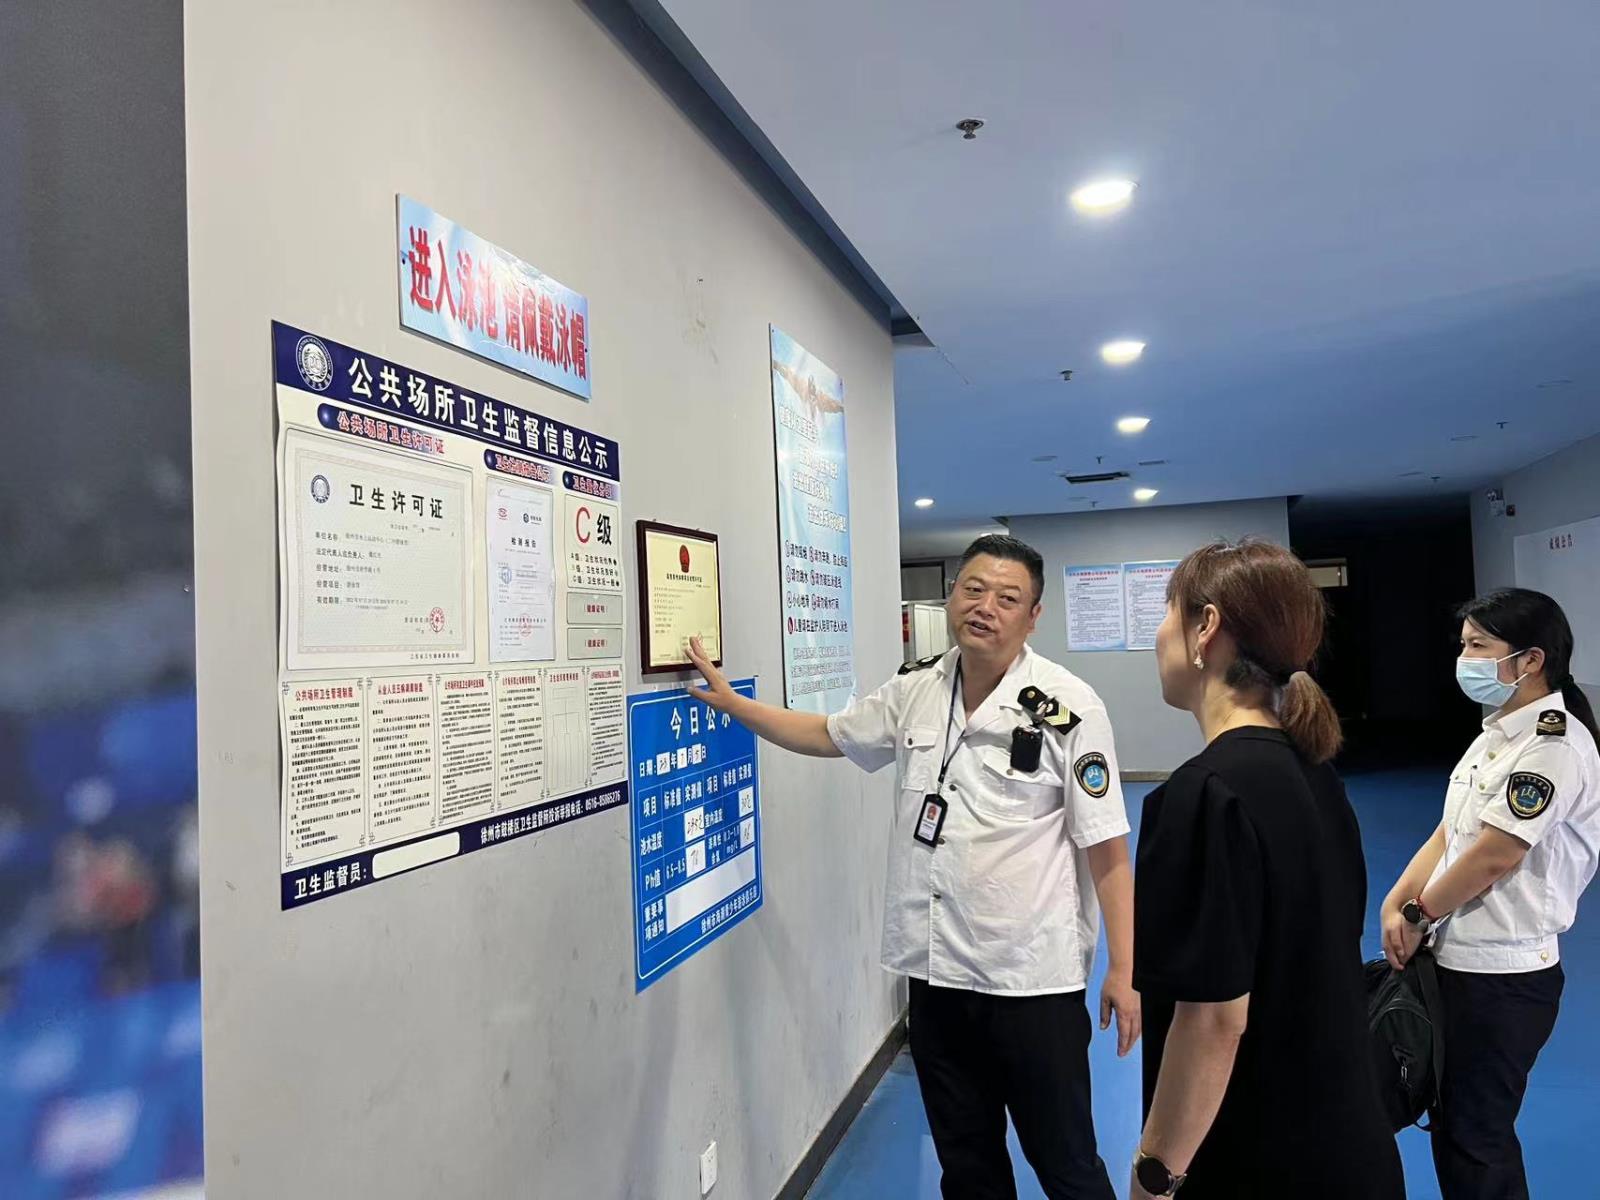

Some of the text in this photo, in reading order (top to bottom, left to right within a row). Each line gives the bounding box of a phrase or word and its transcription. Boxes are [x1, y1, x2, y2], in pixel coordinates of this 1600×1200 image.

[408, 225, 499, 339] 进入泳池
[348, 358, 608, 469] 公共场所卫生监督信息公示
[337, 411, 445, 455] 公共场所卫生许可证
[349, 484, 443, 519] 卫生许可证
[576, 507, 612, 545] C级
[643, 796, 657, 816] 项目
[294, 862, 367, 900] 卫生监督员:
